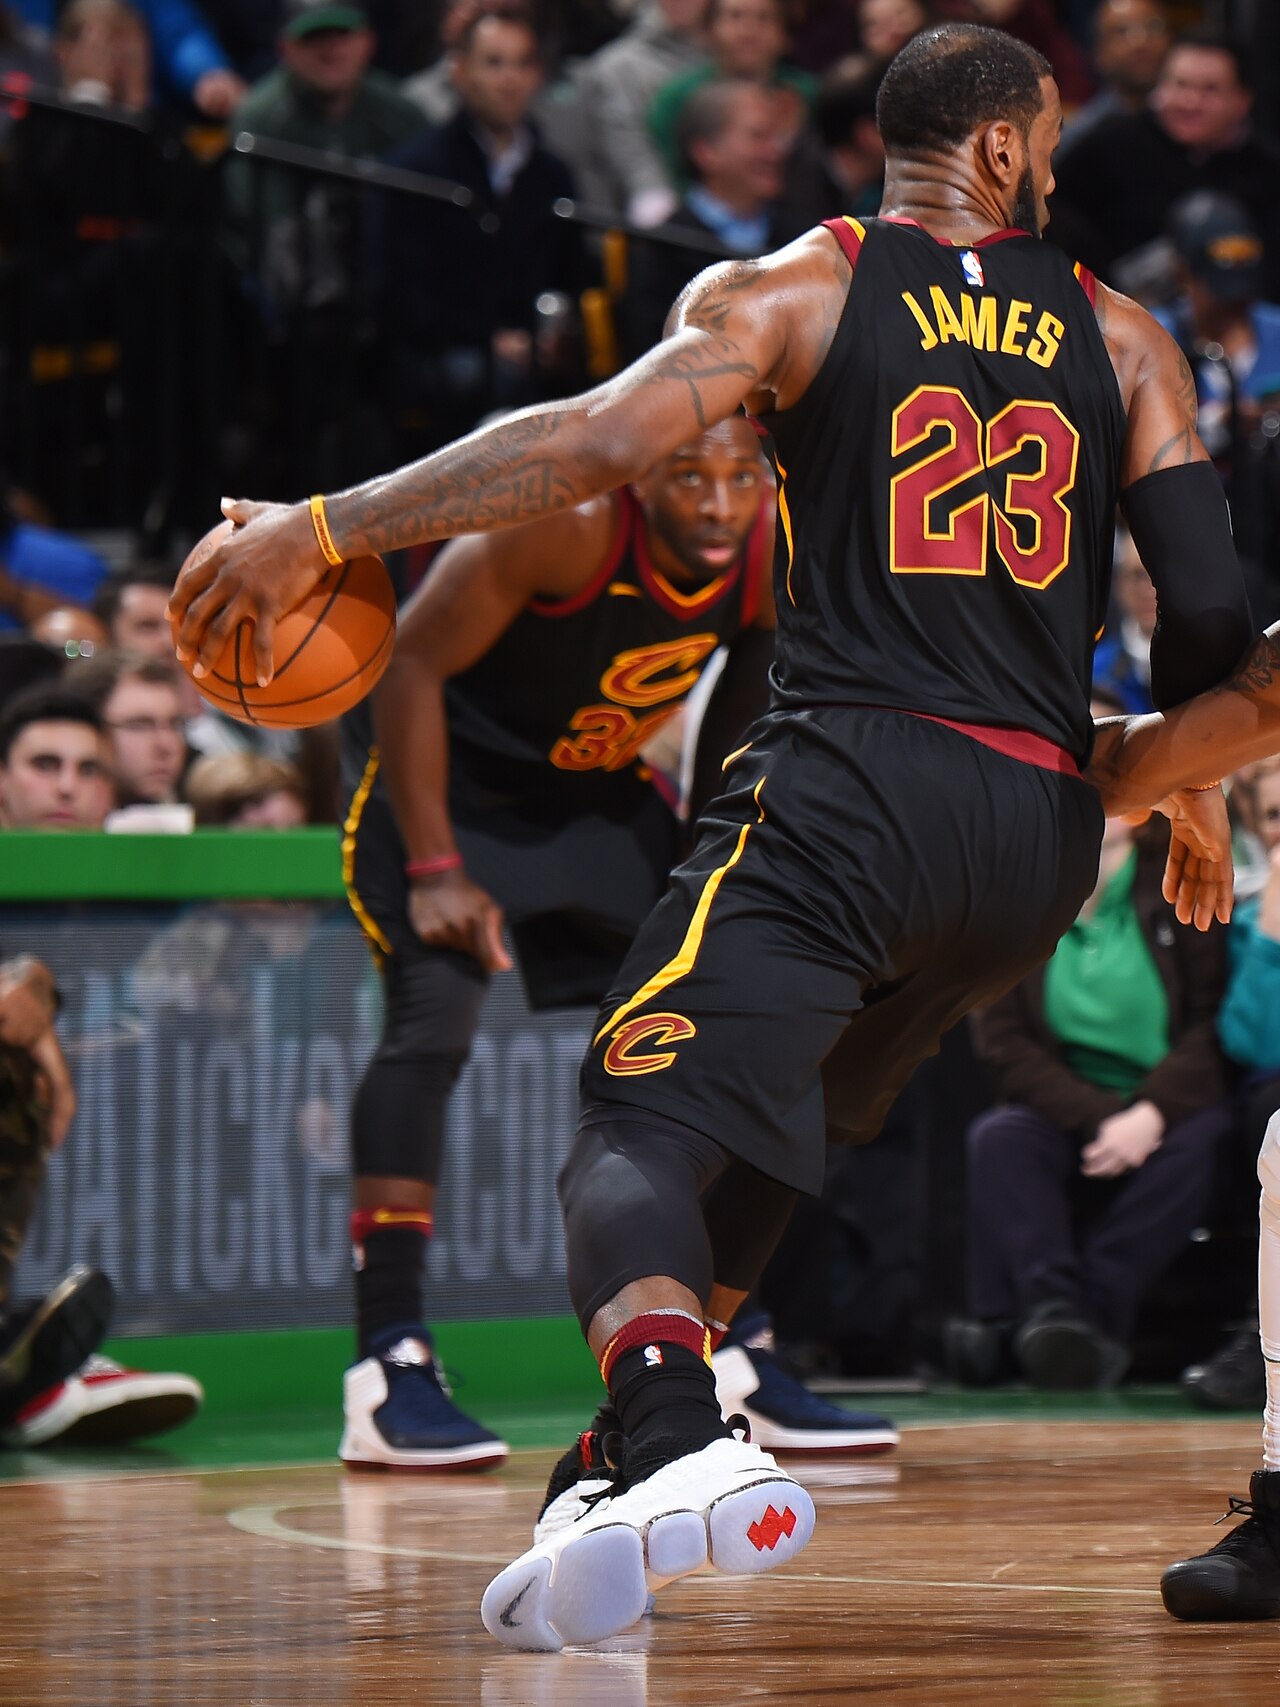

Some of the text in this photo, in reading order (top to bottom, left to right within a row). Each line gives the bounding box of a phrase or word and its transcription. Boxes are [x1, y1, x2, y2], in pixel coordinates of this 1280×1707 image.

[901, 285, 1065, 368] JAMES
[889, 384, 1080, 590] 23
[600, 632, 718, 707] C
[604, 1012, 697, 1076] C
